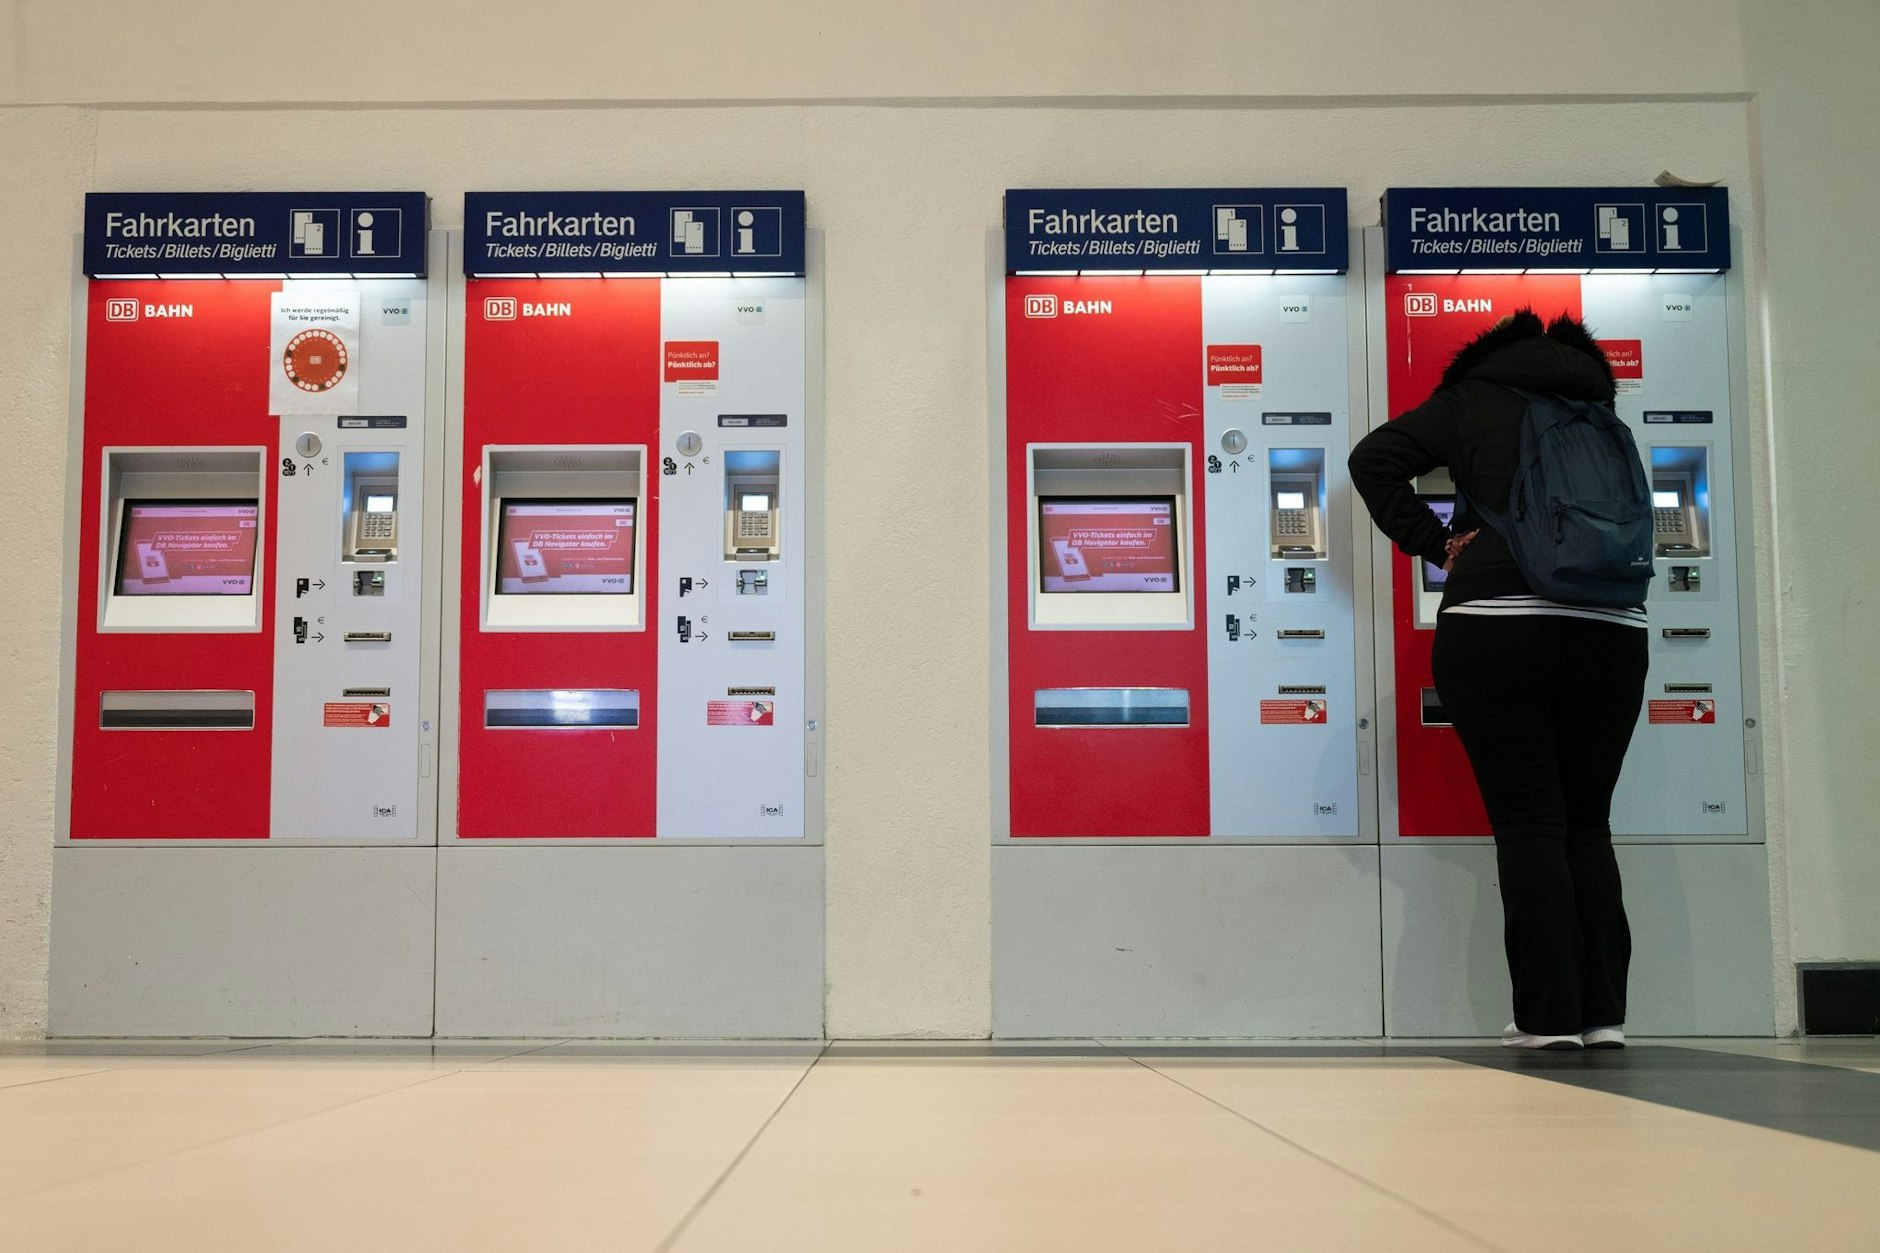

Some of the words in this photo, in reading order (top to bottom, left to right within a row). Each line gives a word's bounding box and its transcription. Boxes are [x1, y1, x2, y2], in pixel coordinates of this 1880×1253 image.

[106, 212, 255, 238] Fahrkarten
[486, 212, 635, 237] Fahrkarten
[1029, 208, 1178, 234] Fahrkarten
[1410, 207, 1560, 233] Fahrkarten
[109, 301, 137, 318] DB
[145, 304, 193, 318] BAHN
[488, 300, 513, 318] DB
[522, 303, 571, 316] BAHN
[1028, 298, 1054, 315] DB
[1064, 300, 1112, 314] BAHN
[1408, 296, 1434, 314] DB
[1444, 299, 1492, 312] BAHN
